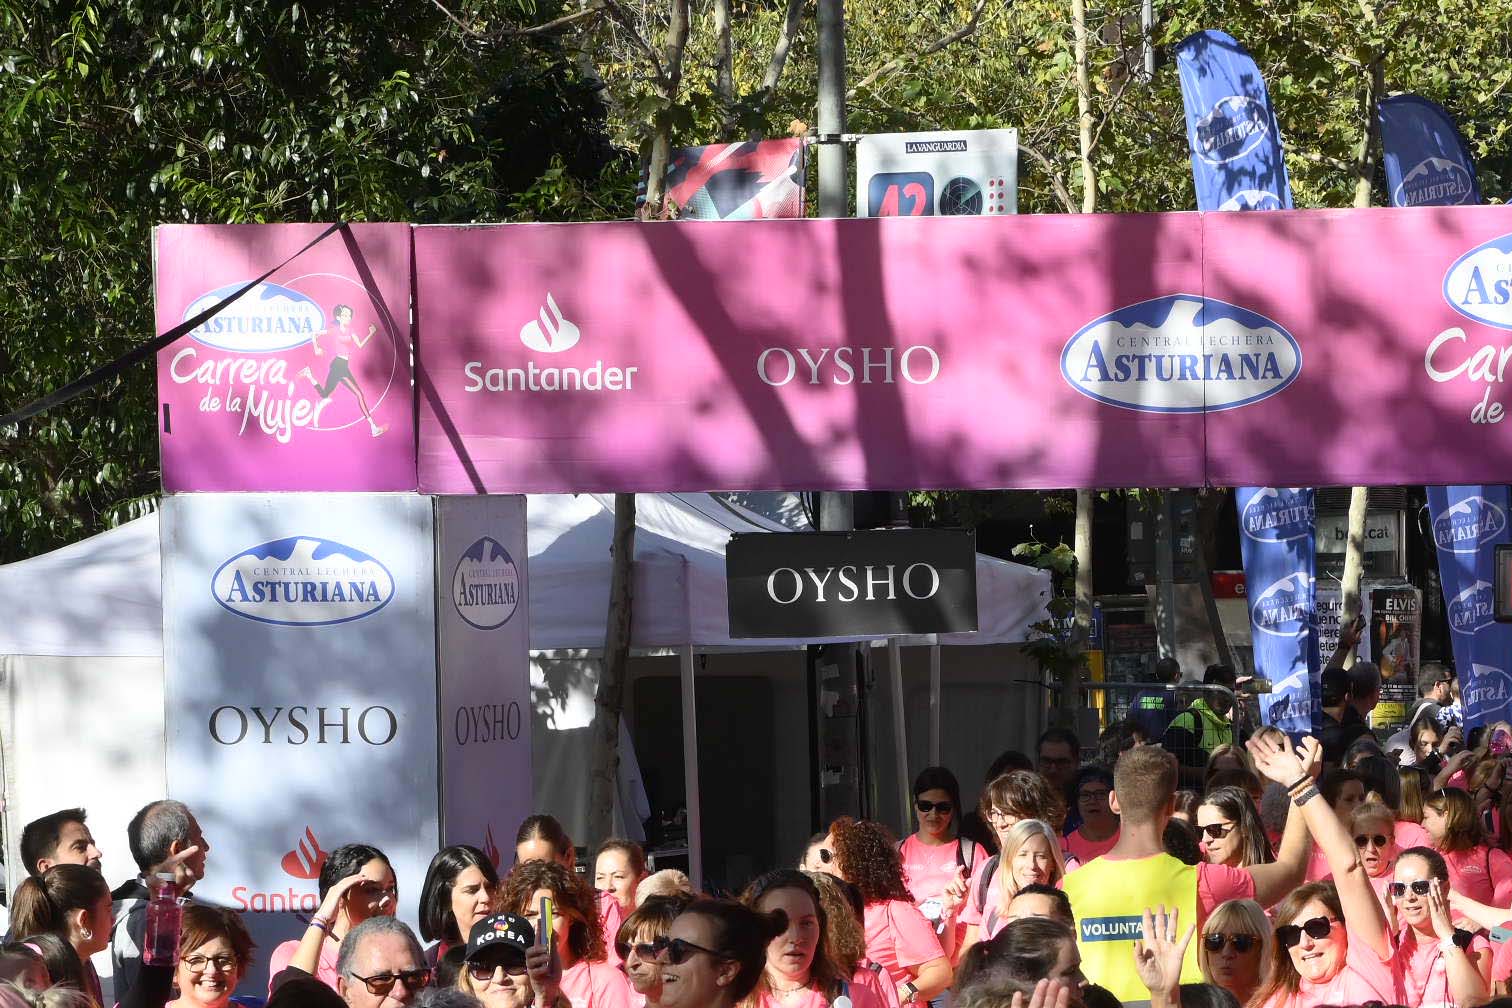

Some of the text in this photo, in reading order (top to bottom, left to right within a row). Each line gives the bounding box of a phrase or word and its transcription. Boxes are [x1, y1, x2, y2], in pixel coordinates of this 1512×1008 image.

[1117, 335, 1274, 348] CENTRAL LECHERA
[170, 347, 287, 384] Carrera
[464, 360, 638, 392] Santander
[757, 344, 941, 387] OYSHO
[1080, 339, 1283, 382] ASTURIANA
[200, 384, 332, 443] de la Mujer
[1470, 385, 1504, 424] de
[225, 569, 382, 602] ASTURIANA
[253, 567, 312, 577] CENTRAL
[458, 571, 515, 607] ASTURIANA
[767, 562, 941, 604] OYSHO
[1386, 598, 1416, 611] ELVIS
[208, 705, 398, 745] OYSHO
[455, 701, 521, 746] OYSHO
[476, 931, 525, 946] KOREA
